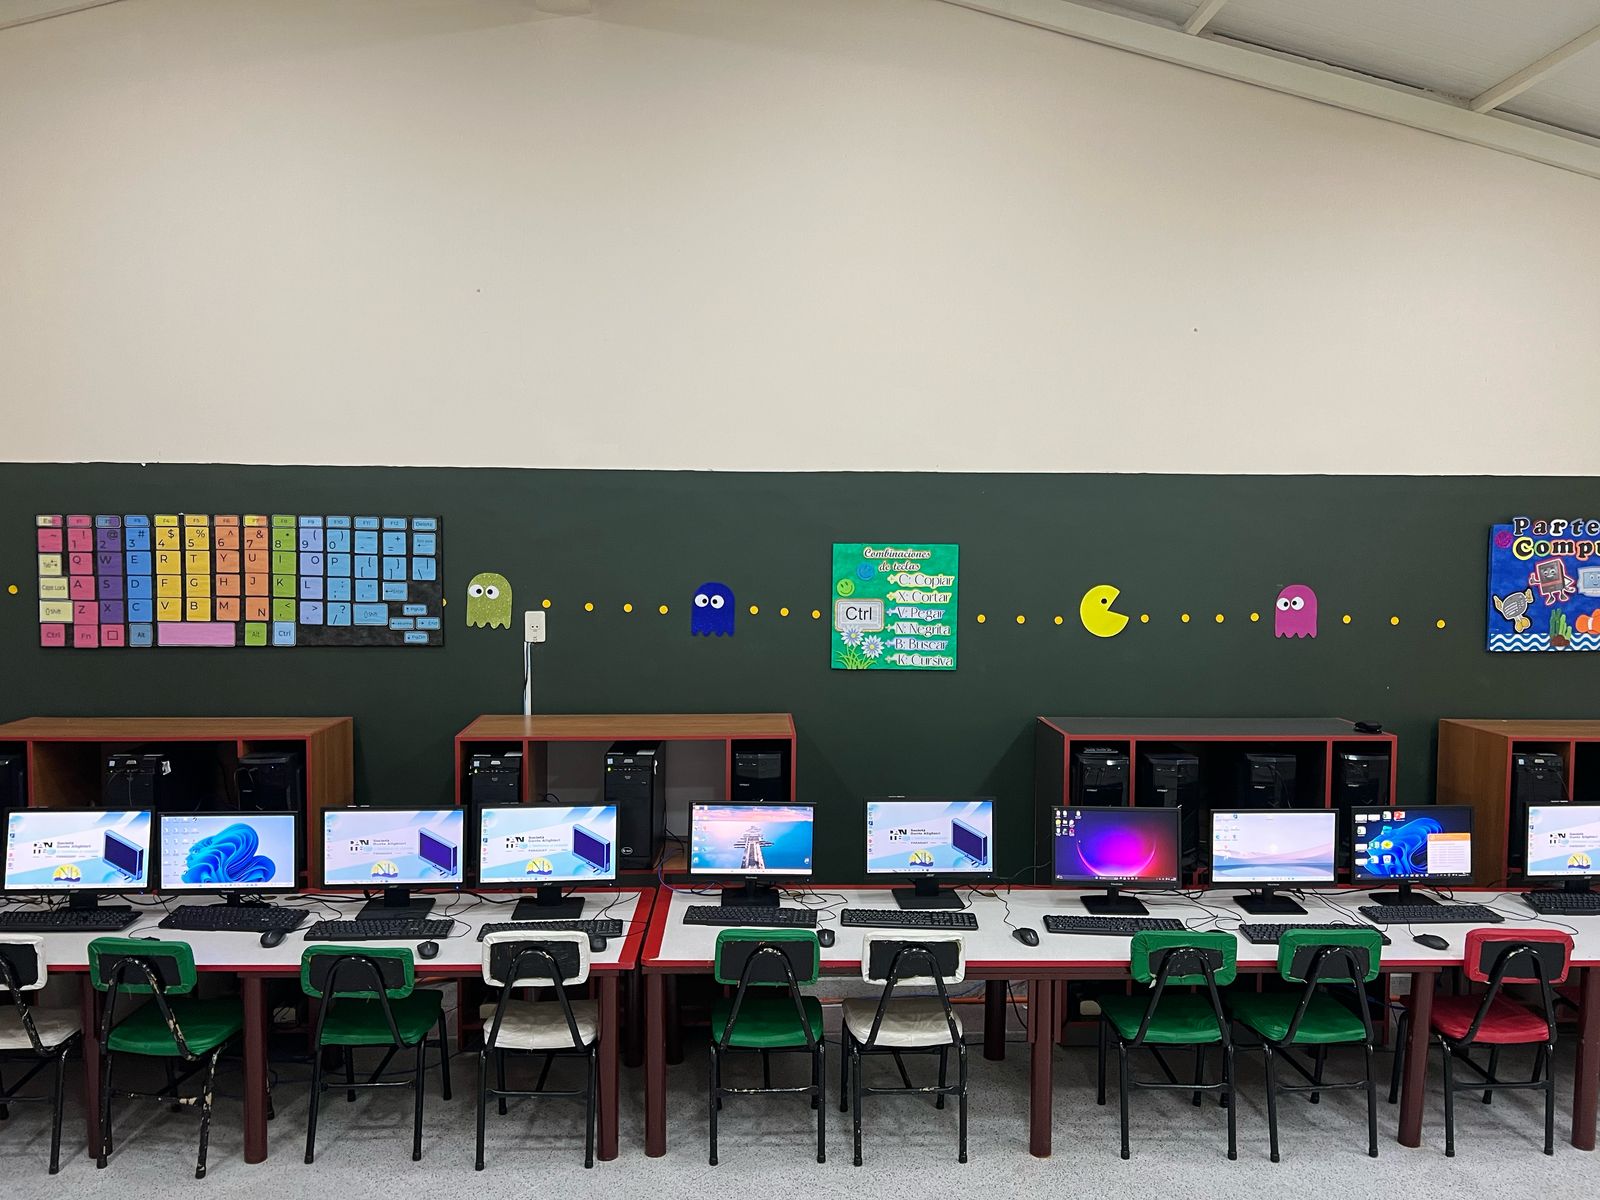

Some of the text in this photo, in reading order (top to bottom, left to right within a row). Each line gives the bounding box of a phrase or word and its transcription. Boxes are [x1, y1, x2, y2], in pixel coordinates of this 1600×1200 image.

[100, 540, 106, 548] 2
[129, 539, 135, 547] 3
[158, 539, 165, 547] 4
[188, 539, 194, 547] 5
[218, 539, 224, 547] 6
[247, 540, 253, 548] 7
[275, 540, 281, 548] 8
[864, 548, 931, 558] Combinaciones
[73, 556, 82, 565] Q
[132, 556, 138, 564] E
[161, 555, 168, 563] R
[220, 554, 227, 562] Y
[249, 554, 256, 562] U
[332, 558, 338, 566] P
[879, 561, 920, 571] de teclas
[103, 580, 110, 589] S
[132, 580, 139, 588] D
[190, 579, 198, 587] G
[220, 578, 227, 586] H
[250, 577, 256, 585] J
[305, 581, 310, 589] L
[899, 574, 953, 588] C: Copiar
[898, 591, 950, 602] X: Cortar
[79, 606, 86, 614] Z
[104, 604, 111, 612] X
[132, 603, 140, 611] C
[161, 602, 169, 610] V
[191, 602, 198, 610] B
[220, 602, 228, 610] M
[258, 609, 266, 617] N
[846, 607, 872, 620] Ctrl
[898, 608, 943, 620] V: Pegar
[896, 623, 950, 636] N: Negrita
[895, 639, 947, 649] B: Buscar
[898, 655, 952, 665] K: Cursiva
